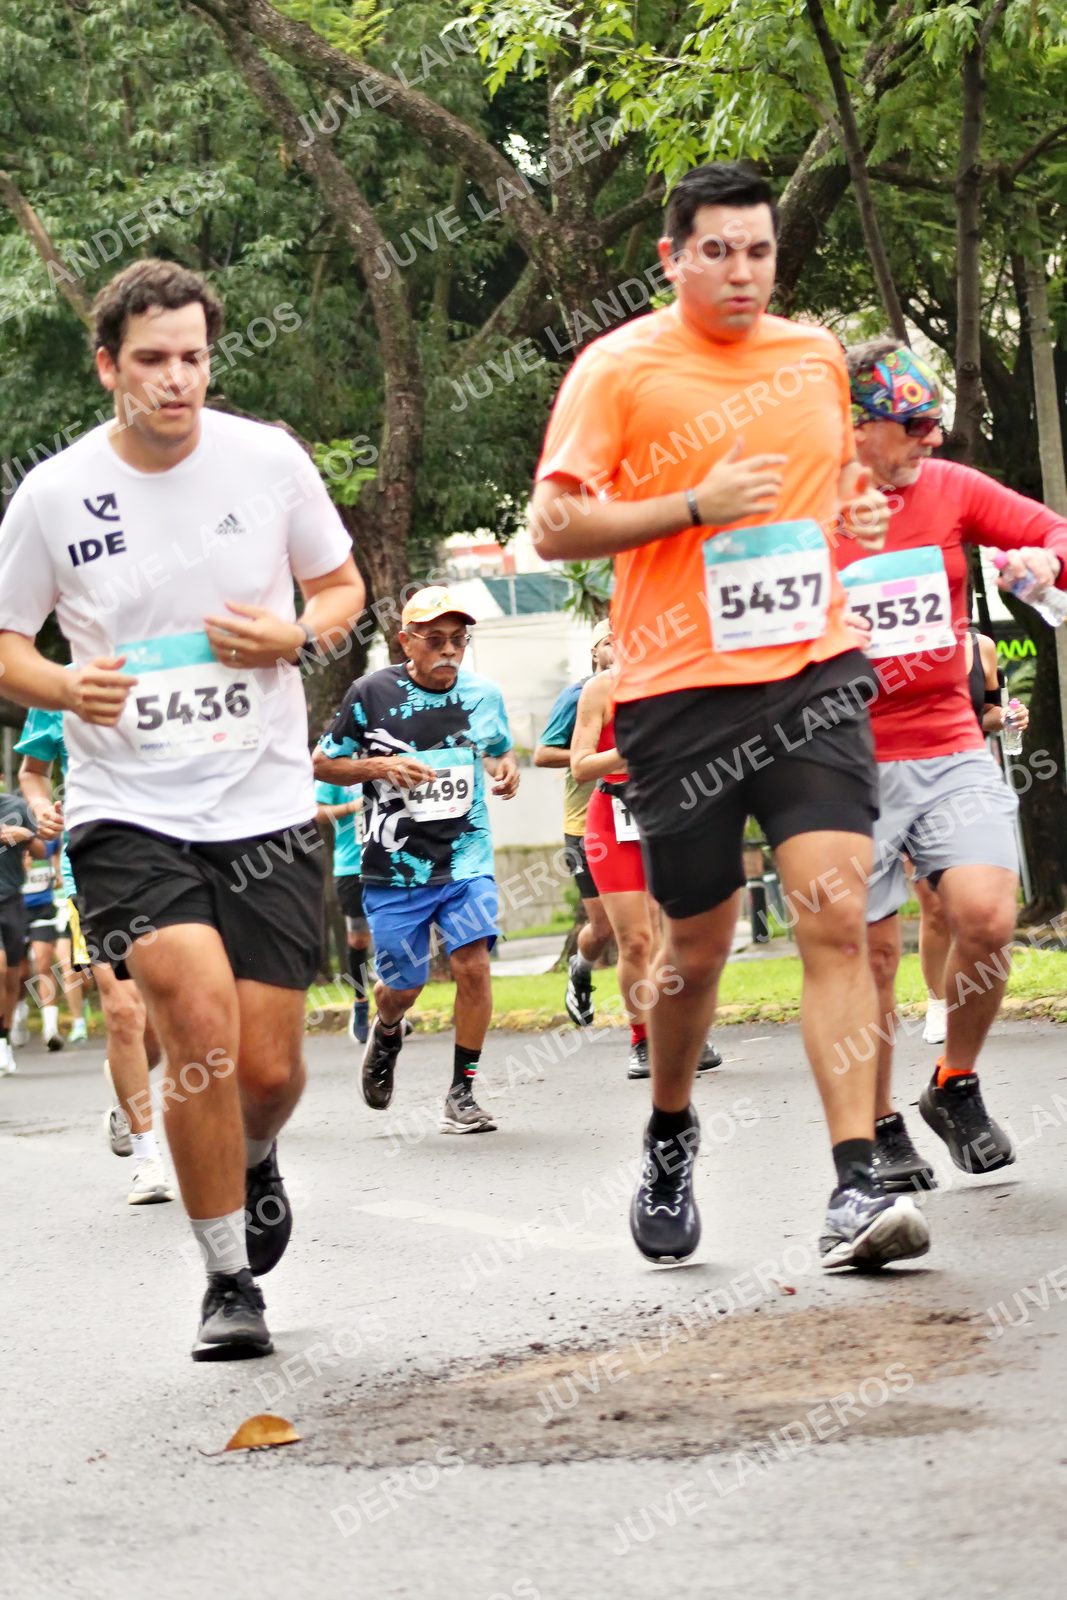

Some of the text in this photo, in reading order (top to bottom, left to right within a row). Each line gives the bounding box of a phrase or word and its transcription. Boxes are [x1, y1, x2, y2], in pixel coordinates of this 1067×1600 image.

[67, 530, 127, 567] IDE
[719, 572, 822, 620] 5437
[850, 592, 944, 632] 3532
[136, 682, 250, 731] 5436
[408, 778, 469, 804] 4499
